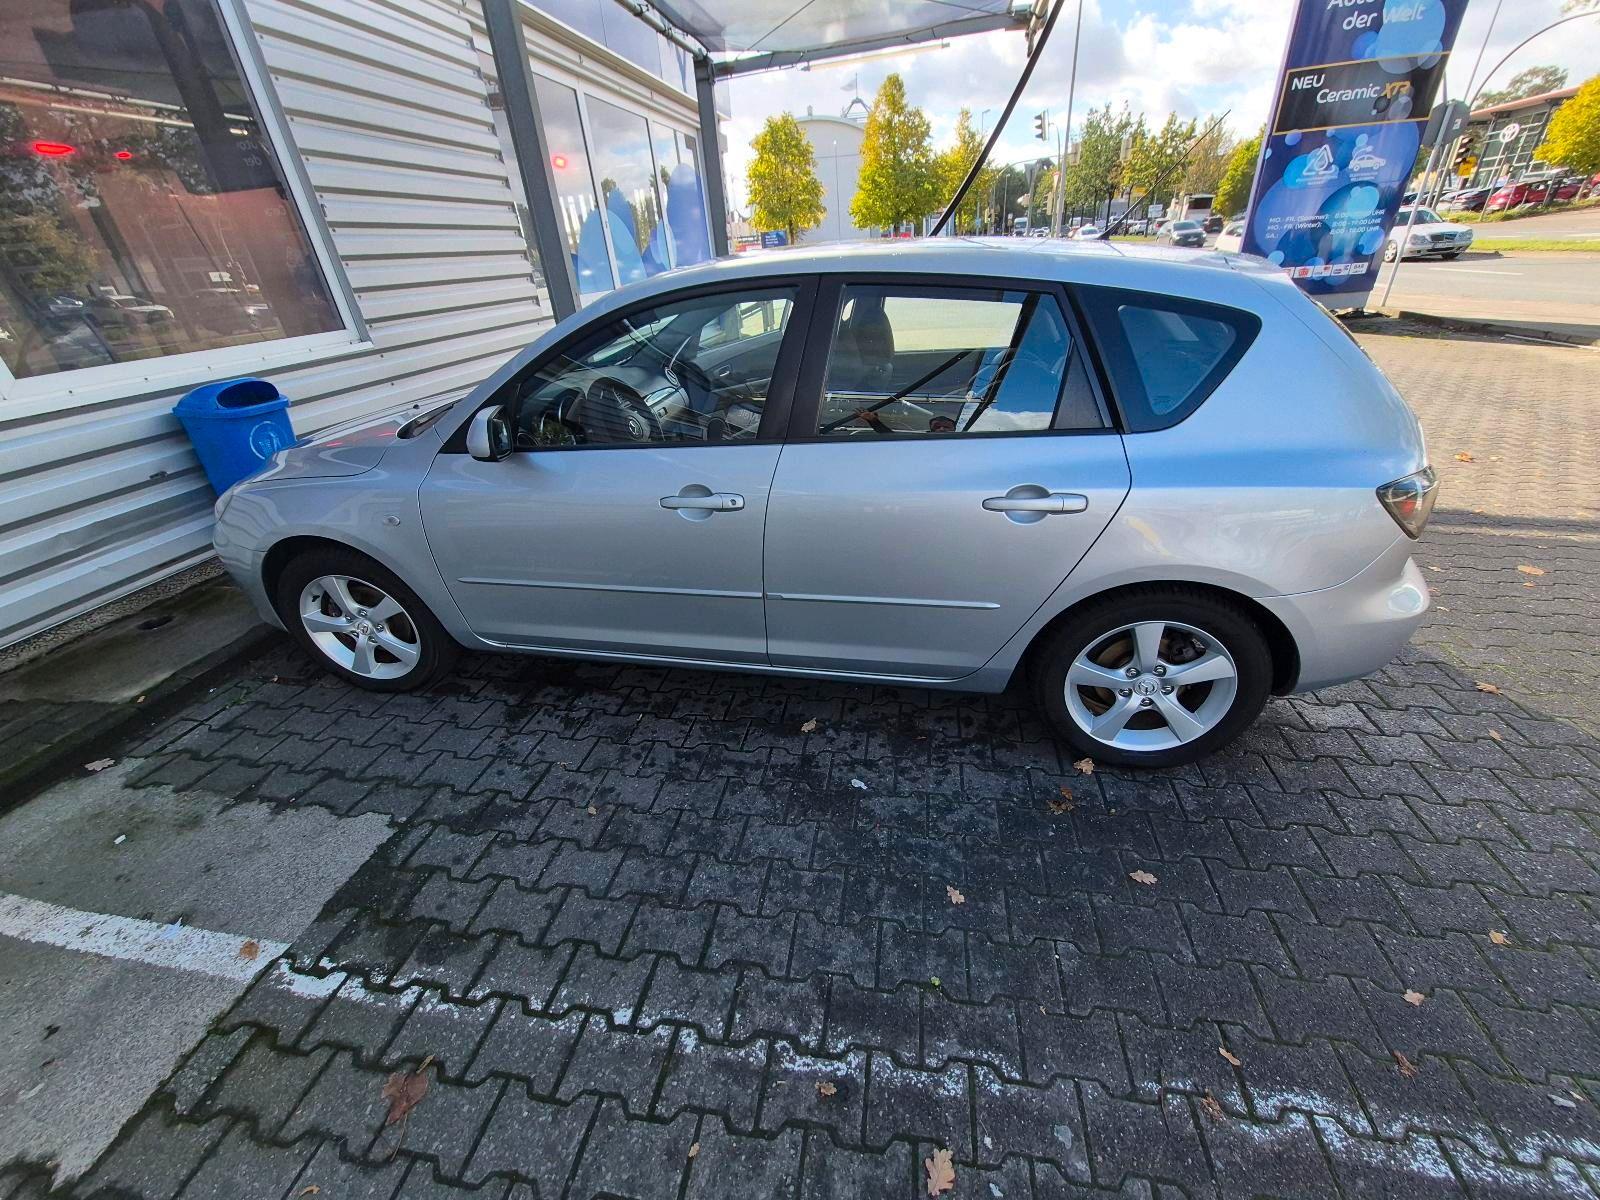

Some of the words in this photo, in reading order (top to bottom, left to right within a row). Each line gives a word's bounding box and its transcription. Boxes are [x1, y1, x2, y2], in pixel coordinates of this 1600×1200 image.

[1326, 0, 1375, 10] Au
[1342, 10, 1378, 30] der
[1382, 3, 1427, 24] Welt
[1291, 74, 1326, 91] NEU
[1316, 83, 1381, 104] Ceramic
